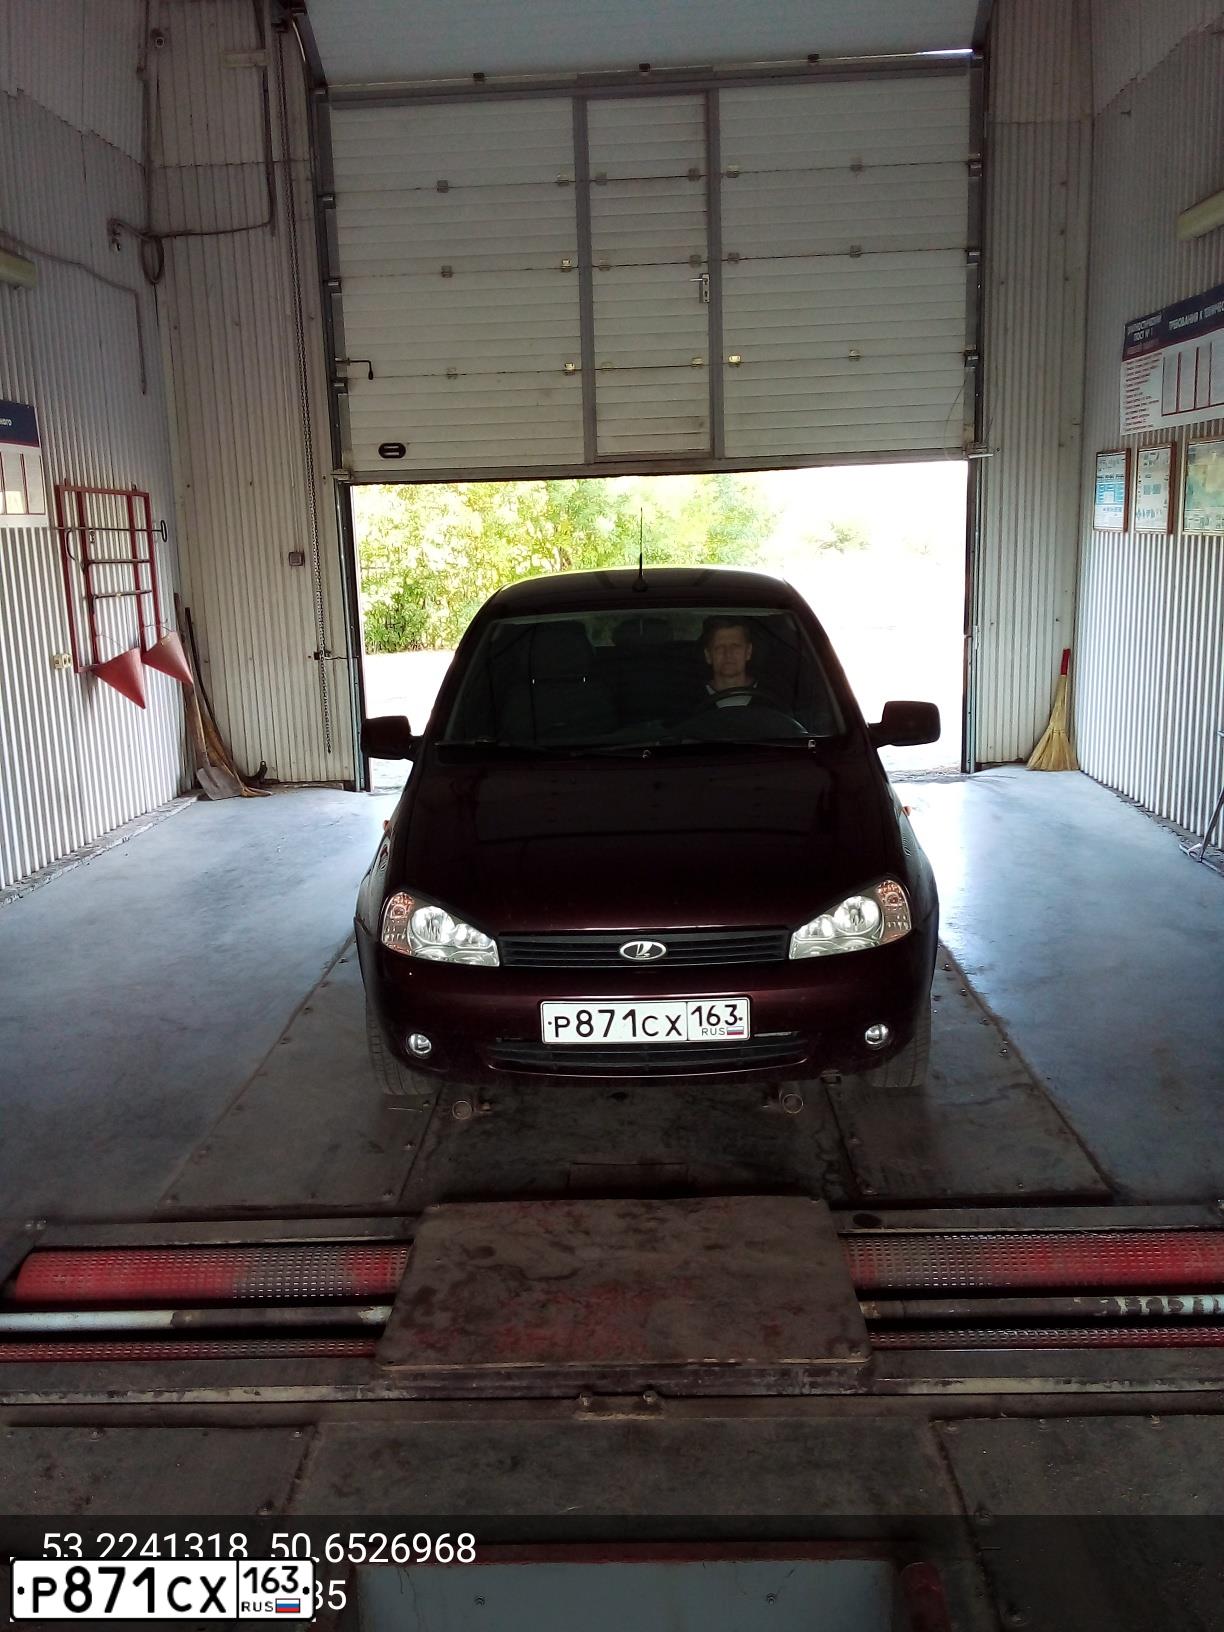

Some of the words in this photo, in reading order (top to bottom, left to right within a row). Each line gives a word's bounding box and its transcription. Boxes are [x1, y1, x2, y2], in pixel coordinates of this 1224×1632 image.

[554, 1008, 683, 1038] Р871СХ
[691, 1004, 738, 1027] 163
[701, 1027, 726, 1036] RUS
